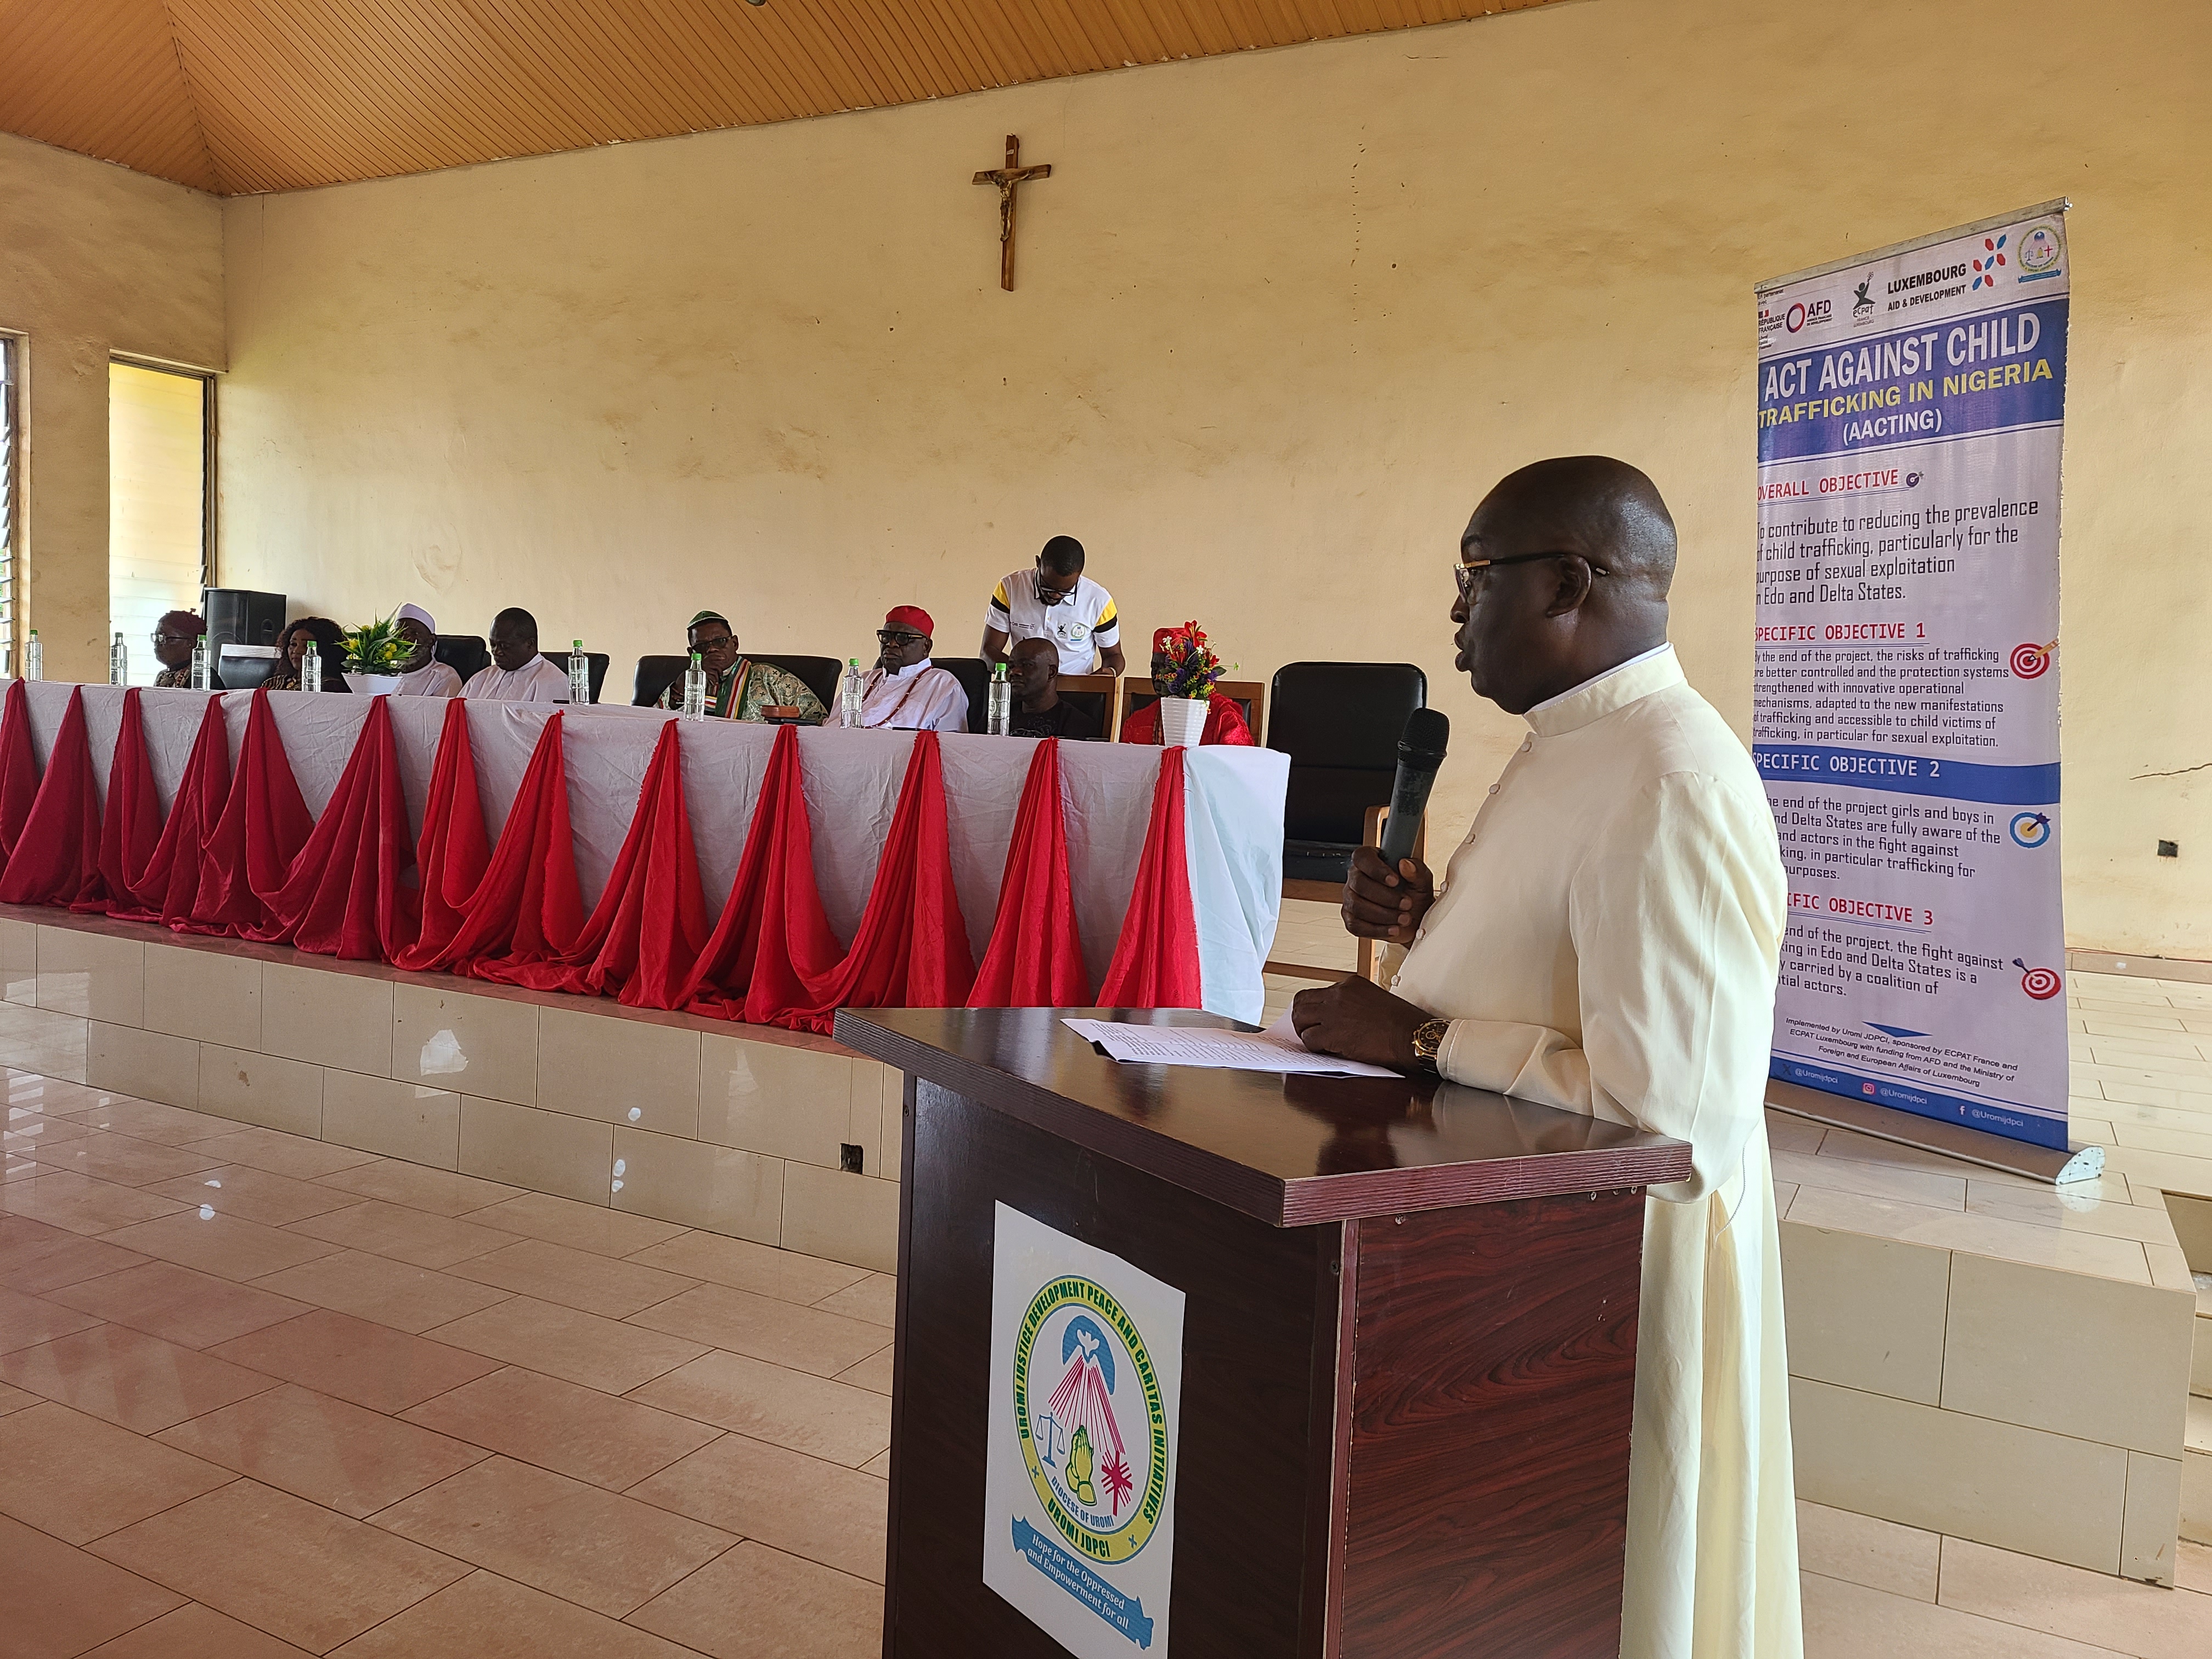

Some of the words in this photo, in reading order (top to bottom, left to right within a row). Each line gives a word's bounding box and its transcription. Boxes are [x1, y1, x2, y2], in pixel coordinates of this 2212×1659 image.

[1888, 263, 1966, 295] LUXEMBOURG
[1807, 300, 1831, 317] AFD
[1853, 304, 1874, 318] ecpat
[1888, 301, 1900, 311] AID
[1903, 299, 1907, 308] &
[1910, 285, 1966, 306] DEVELOPMENT
[1758, 314, 1785, 326] RÉPUBLIQUE
[1758, 322, 1782, 334] FRANÇAISE
[1765, 359, 1812, 402] ACT
[1818, 333, 1938, 392] AGAINST
[1947, 312, 2040, 366] CHILD
[1759, 386, 1900, 428] TRAFFICKING
[1909, 380, 1933, 403] IN
[1944, 359, 2052, 396] NIGERIA
[1843, 409, 1942, 445] (AACTING)
[1758, 481, 1809, 500] OVERALL
[1820, 469, 1898, 493] OBJECTIVE
[1769, 517, 1837, 538] contribute
[1843, 516, 1854, 531] to
[1859, 510, 1920, 529] reducing
[1926, 505, 1949, 524] the
[1955, 498, 2038, 526] prevalence
[1767, 541, 1795, 561] child
[1800, 537, 1874, 558] trafficking,
[1879, 527, 1963, 556] particularly
[1968, 526, 1990, 545] for
[1996, 523, 2018, 543] the
[1807, 562, 1820, 580] of
[1825, 559, 1865, 579] sexual
[1871, 556, 1955, 579] exploitation
[1764, 586, 1784, 605] Edo
[1790, 585, 1814, 603] and
[1820, 584, 1853, 602] Delta
[1859, 582, 1906, 600] States.
[1756, 625, 1815, 641] SPECIFIC
[1826, 623, 1905, 640] OBJECTIVE
[1916, 623, 1926, 638] 1
[1755, 651, 1760, 664] By
[1763, 651, 1775, 662] the
[1779, 650, 1797, 662] end
[1801, 650, 1812, 662] of
[1815, 650, 1831, 662] the
[1835, 650, 1873, 663] project,
[1877, 649, 1893, 661] the
[1897, 648, 1923, 661] risks
[1928, 648, 1940, 660] of
[1944, 648, 1999, 663] trafficking
[1767, 665, 1797, 677] better
[1801, 665, 1854, 677] controlled
[1858, 665, 1875, 677] and
[1880, 665, 1896, 677] the
[1900, 667, 1960, 680] protection
[1963, 668, 2009, 680] systems
[1818, 681, 1839, 693] with
[1843, 682, 1895, 693] innovative
[1899, 681, 1964, 696] operational
[1753, 696, 1812, 709] mechanisms,
[1816, 697, 1856, 710] adapted
[1860, 699, 1870, 709] to
[1874, 698, 1891, 710] the
[1894, 701, 1916, 710] new
[1921, 698, 2004, 713] manifestations
[1753, 712, 1759, 722] of
[1760, 712, 1811, 725] trafficking
[1815, 713, 1834, 724] and
[1838, 714, 1892, 726] accessible
[1895, 715, 1906, 726] to
[1910, 714, 1938, 727] child
[1942, 716, 1981, 729] victims
[1985, 717, 1996, 729] of
[1753, 726, 1800, 740] trafficking,
[1804, 729, 1813, 739] in
[1817, 729, 1869, 741] particular
[1872, 730, 1888, 742] for
[1892, 731, 1927, 743] sexual
[1932, 732, 1999, 747] exploitation.
[1753, 752, 1819, 770] SPECIFIC
[1830, 756, 1917, 776] OBJECTIVE
[1930, 761, 1939, 777] 2
[1829, 898, 1912, 922] OBJECTIVE
[1924, 910, 1933, 925] 3
[1808, 927, 1819, 939] of
[1822, 929, 1841, 943] the
[1846, 936, 1893, 952] project,
[1898, 940, 1917, 955] the
[1922, 943, 1953, 961] fight
[1957, 954, 2004, 970] against
[1790, 961, 1833, 976] carried
[1839, 965, 1852, 982] by
[1856, 972, 1861, 981] a
[1867, 974, 1920, 991] coalition
[1926, 981, 1939, 995] of
[1804, 980, 1846, 996] actors.
[1786, 1018, 1830, 1032] Implemented
[1842, 1029, 1862, 1039] Uromi
[1892, 1039, 1931, 1052] sponsored
[1932, 1047, 1942, 1056] by
[1944, 1049, 1972, 1060] ECPAT
[1973, 1056, 2000, 1067] France
[2002, 1062, 2018, 1070] and
[1790, 1029, 1814, 1039] ECPAT
[1816, 1034, 1858, 1049] Luxembourg
[1860, 1043, 1874, 1052] with
[1876, 1047, 1904, 1058] funding
[1906, 1052, 1922, 1062] from
[1923, 1057, 1940, 1065] AFD
[1973, 1067, 2004, 1081] Ministry
[1795, 1068, 1838, 1084] @Uromijdpci
[1819, 1046, 1844, 1057] Foreign
[1861, 1056, 1897, 1068] European
[1898, 1063, 1921, 1073] Affairs
[1932, 1070, 1980, 1087] Luxembourg
[1880, 1087, 1927, 1104] @Uromijdpci
[1972, 1109, 2023, 1127] @Uromijdpci
[1028, 1281, 1085, 1326] DEVELOPMENT
[1087, 1285, 1119, 1322] PEACE
[1117, 1317, 1138, 1350] AND
[1016, 1322, 1036, 1383] JUSTICE
[1135, 1348, 1163, 1425] CARITAS
[1015, 1385, 1029, 1439] UROMI
[1143, 1429, 1165, 1524] INITIATIVES
[1051, 1476, 1079, 1516] DIOCESE
[1080, 1510, 1089, 1522] OF
[1090, 1515, 1114, 1528] UROMI
[1047, 1498, 1079, 1543] UROMI
[1081, 1538, 1110, 1558] JDPCI
[1032, 1534, 1052, 1557] Hope
[1053, 1549, 1065, 1565] for
[1066, 1560, 1079, 1576] the
[1081, 1571, 1125, 1610] Oppressed
[1028, 1548, 1042, 1565] and
[1043, 1558, 1102, 1609] Empowerment
[1101, 1602, 1116, 1619] for
[1117, 1613, 1129, 1629] all
